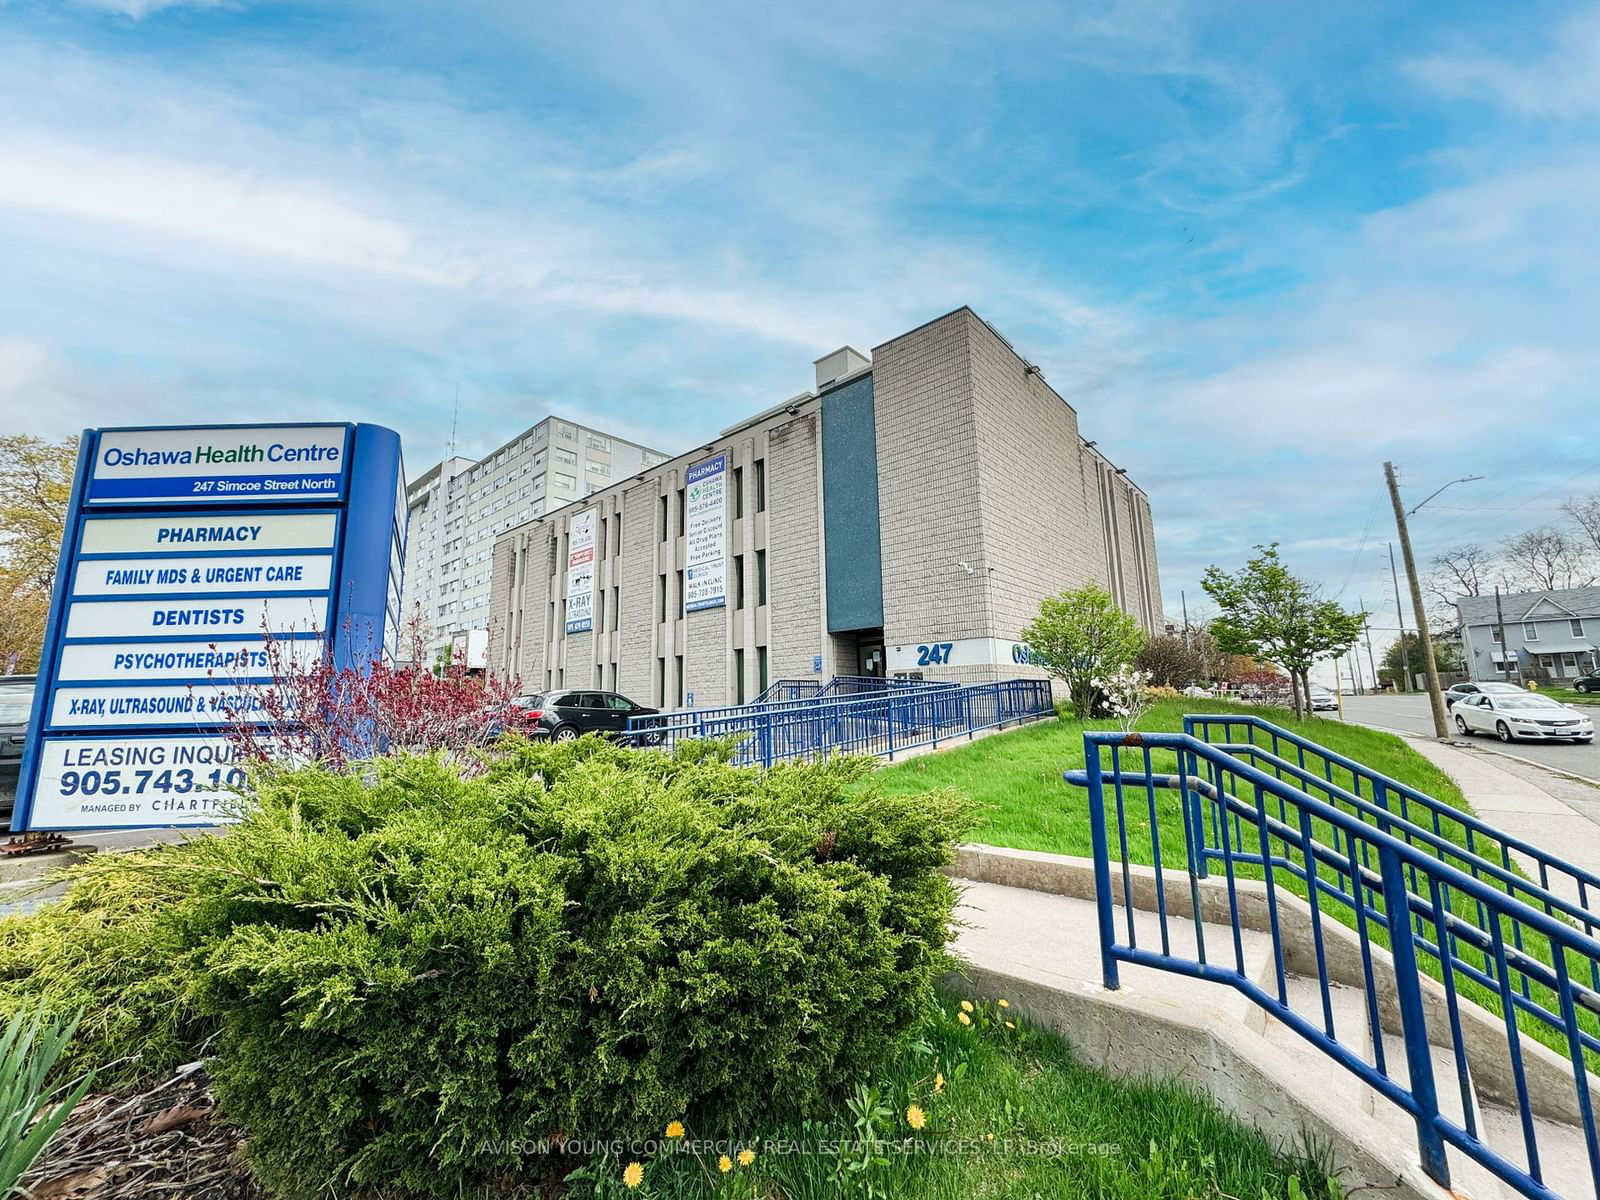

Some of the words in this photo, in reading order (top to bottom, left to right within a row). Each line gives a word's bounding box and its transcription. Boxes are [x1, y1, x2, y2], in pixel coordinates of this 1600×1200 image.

[103, 447, 192, 467] Oshawa
[195, 445, 264, 465] Health
[267, 443, 339, 462] Centre
[688, 459, 723, 481] PHARMACY
[193, 480, 215, 493] 247
[217, 479, 261, 492] Simcoe
[264, 478, 300, 491] Street
[302, 478, 336, 490] North
[702, 488, 723, 500] CENTRE
[157, 526, 262, 543] PHARMACY
[690, 553, 701, 561] Free
[701, 549, 721, 558] Parking
[105, 569, 154, 586] FAMILY
[157, 568, 187, 585] MDS
[190, 568, 202, 584] &
[205, 566, 263, 583] URGENT
[266, 566, 303, 582] CARE
[152, 609, 245, 626] DENTISTS
[114, 651, 268, 670] PSYCHOTHERAPISTS
[917, 643, 953, 666] 247
[109, 696, 193, 715] ULTRASOUND
[196, 695, 206, 713] &
[210, 694, 272, 714] VASCUL
[63, 745, 166, 767] LEASING
[60, 767, 250, 797] 905.743.10
[80, 803, 127, 814] MANAGED
[128, 803, 142, 813] BY
